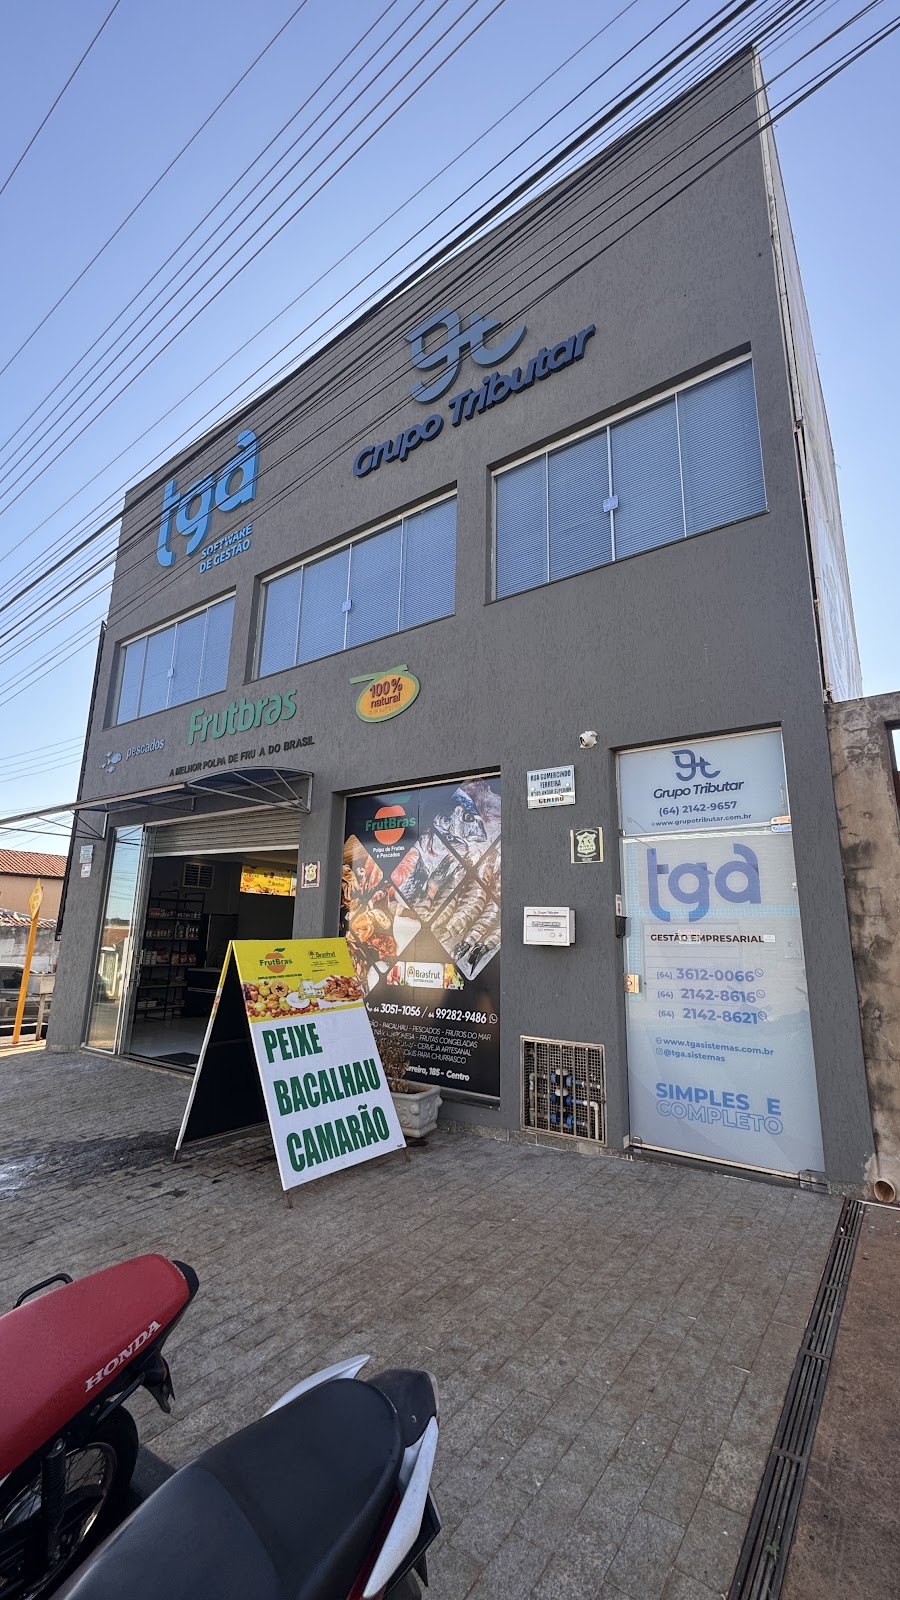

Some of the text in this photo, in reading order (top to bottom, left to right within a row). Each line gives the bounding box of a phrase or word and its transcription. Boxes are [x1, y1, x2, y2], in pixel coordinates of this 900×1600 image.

[353, 324, 596, 478] Grupo Tributar
[201, 522, 254, 560] SOFTWARE
[199, 538, 251, 574] DE GESTÃO
[370, 677, 403, 698] 100%
[370, 692, 401, 708] natural
[187, 689, 298, 745] Frutbras
[126, 737, 166, 761] pescados
[175, 763, 202, 776] MELHOR
[203, 757, 226, 769] POLPA
[228, 754, 239, 764] DE
[268, 743, 281, 755] DO
[283, 735, 315, 751] BRASIL
[653, 781, 745, 799] Grupo Tributar
[659, 801, 737, 817] (64) 2142-9657
[365, 816, 417, 832] FrutBras
[655, 814, 752, 827] www.grupotributar.com.br
[650, 932, 688, 942] GESTÃO
[691, 933, 765, 943] EMPRESARIAL
[259, 958, 293, 966] FrutBras
[415, 970, 441, 980] Brasfrut
[656, 968, 755, 983] (64) 3612-0066
[657, 987, 757, 1004] (64) 2142-8616
[380, 1003, 421, 1017] 3051-1056
[435, 1007, 487, 1024] 9.9282-9486
[658, 1007, 758, 1025] (64) 2142-8621
[412, 1025, 441, 1035] PESCADOS
[445, 1029, 467, 1038] FRUTOS
[478, 1033, 491, 1041] MAR
[419, 1034, 438, 1043] FRUTAS
[439, 1037, 478, 1048] CONGELADAS
[261, 1022, 323, 1064] PEIXE
[417, 1042, 440, 1052] CERVEJA
[440, 1045, 472, 1057] ARTESANAL
[663, 1037, 775, 1056] www.tgasistemas.com.br
[417, 1050, 431, 1059] PARA
[431, 1052, 467, 1065] CHURRASCO
[663, 1049, 726, 1062] @tga.sistemas
[429, 1066, 440, 1077] 185
[446, 1069, 470, 1082] Centro
[273, 1058, 381, 1117] BACALHAU
[655, 1082, 782, 1116] SIMPLES E
[655, 1099, 784, 1136] COMPLETO
[285, 1103, 390, 1173] CAMARÃO
[85, 1320, 161, 1392] HONDA
